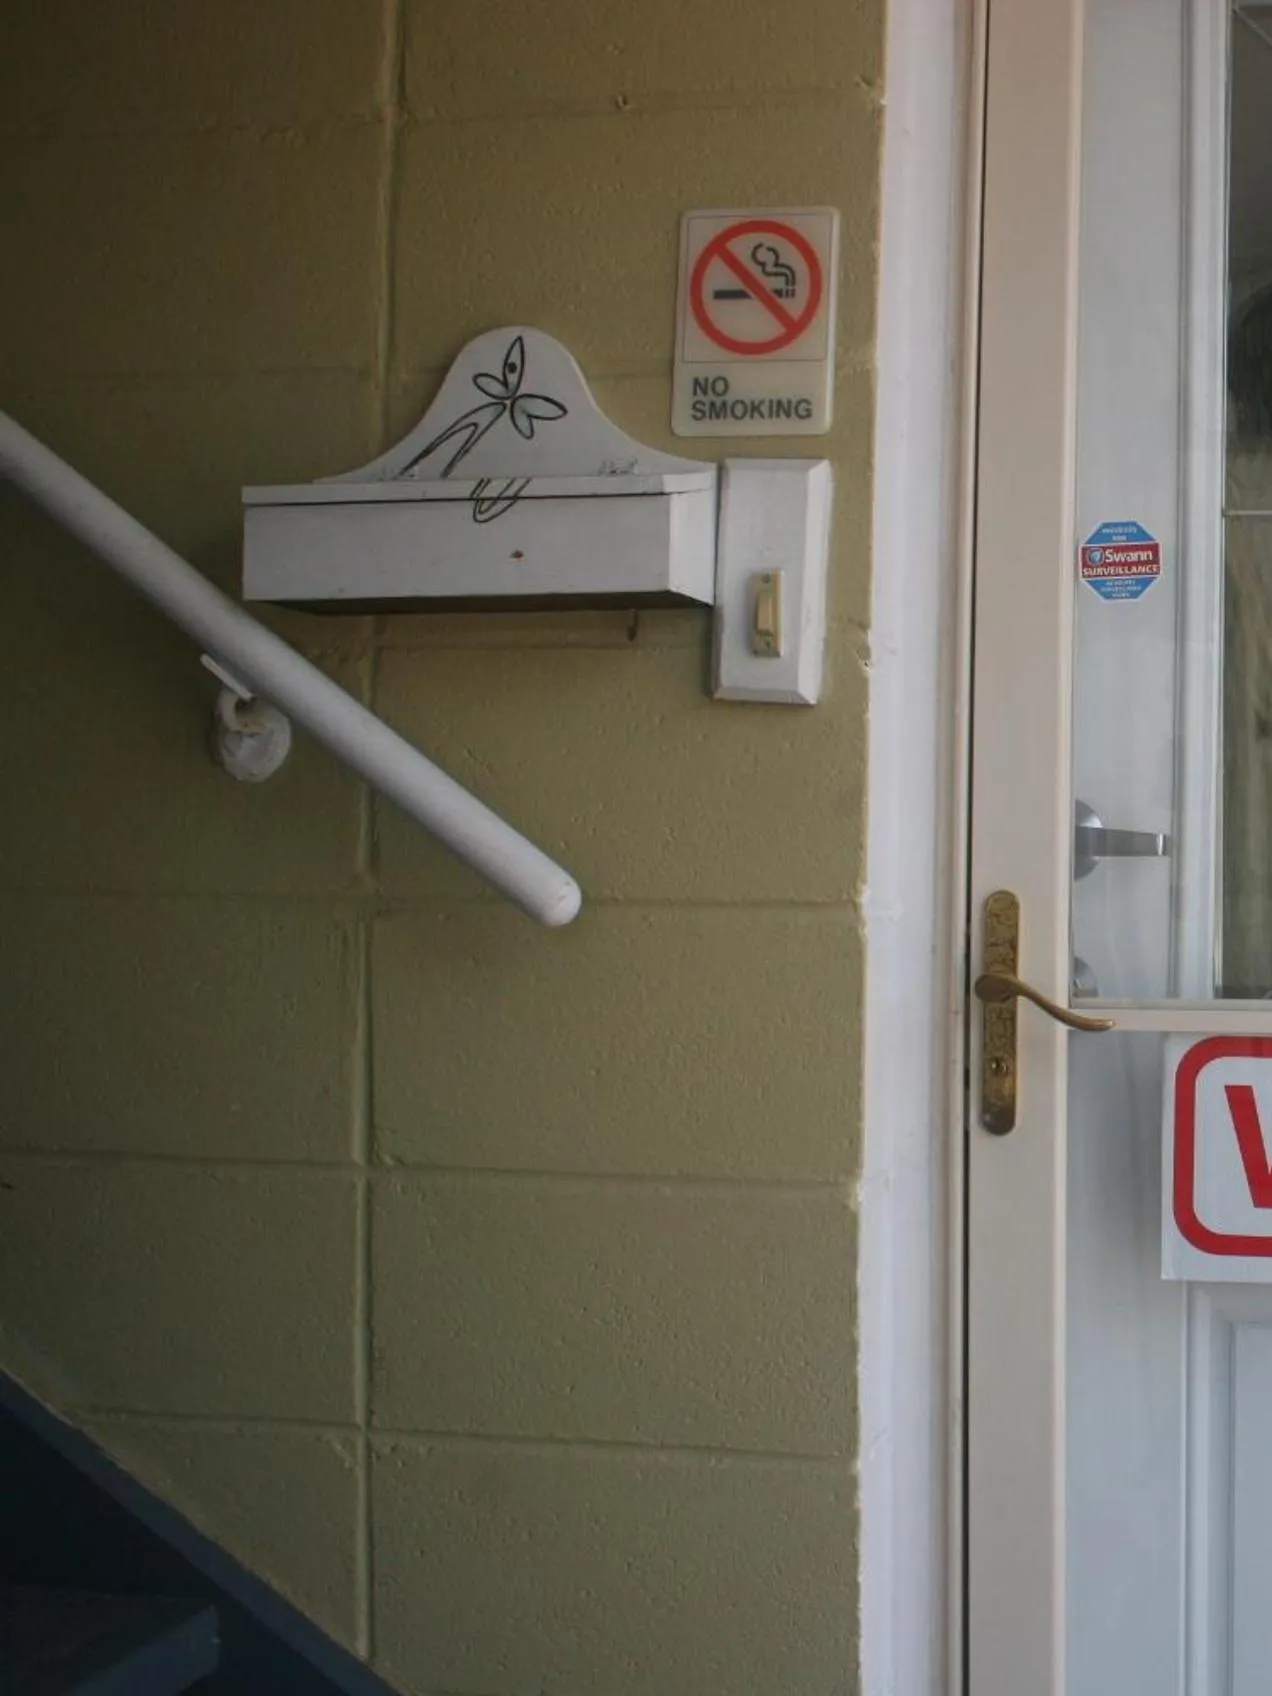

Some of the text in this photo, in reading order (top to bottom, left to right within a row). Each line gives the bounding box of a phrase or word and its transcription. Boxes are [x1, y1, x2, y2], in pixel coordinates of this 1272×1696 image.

[692, 376, 729, 397] NO
[691, 399, 813, 421] SMOKING
[1105, 549, 1153, 562] Swann
[1083, 564, 1157, 576] SURVEILLANCE
